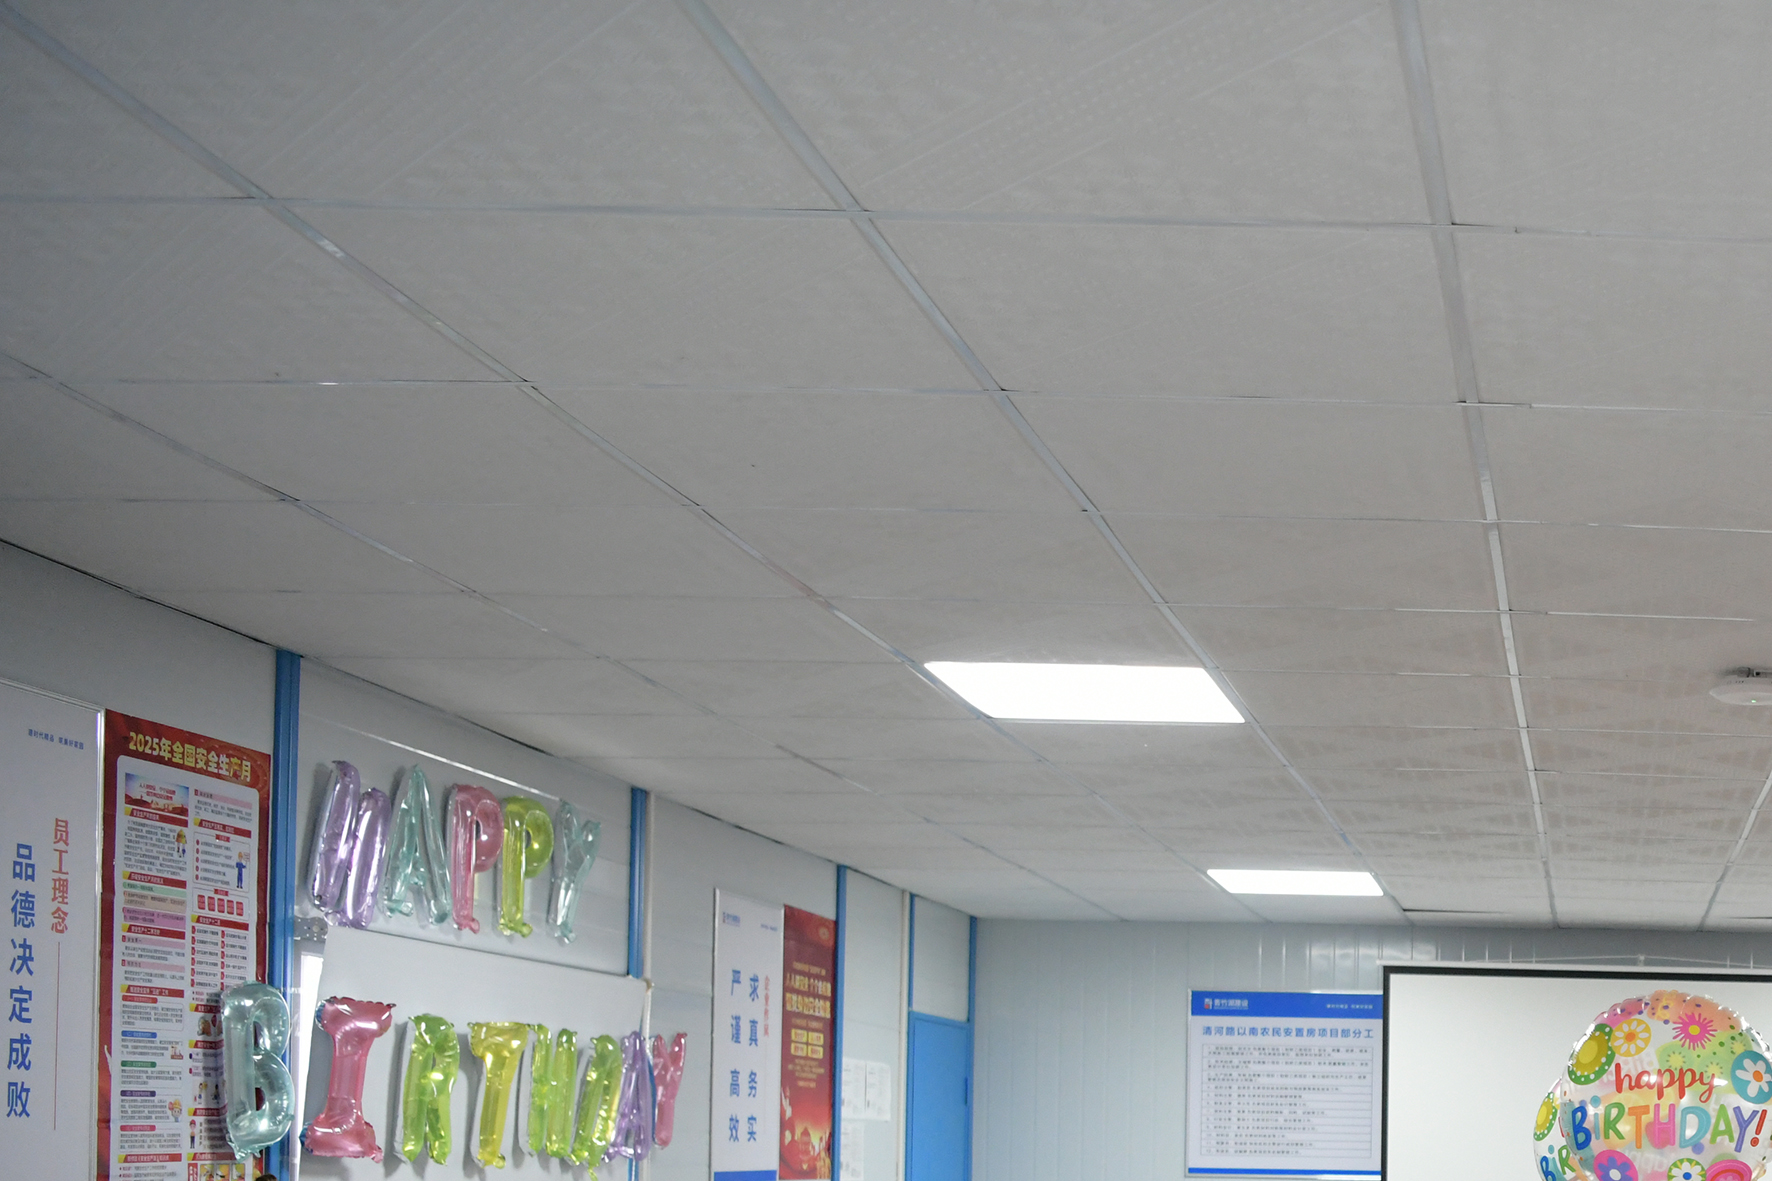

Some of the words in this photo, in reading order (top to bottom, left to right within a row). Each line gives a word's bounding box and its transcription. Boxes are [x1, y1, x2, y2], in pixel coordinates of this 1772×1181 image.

[129, 731, 252, 782] 2025年全国安全生产月
[51, 818, 69, 934] 员工理念
[309, 760, 600, 944] HAPPY
[6, 843, 35, 1119] 品德决定成败
[1202, 1026, 1374, 1039] 清河路以南农民安置房项目部分工
[729, 969, 741, 1143] 严谨高效
[747, 973, 759, 1142] 求真务实
[1615, 1062, 1716, 1103] happy
